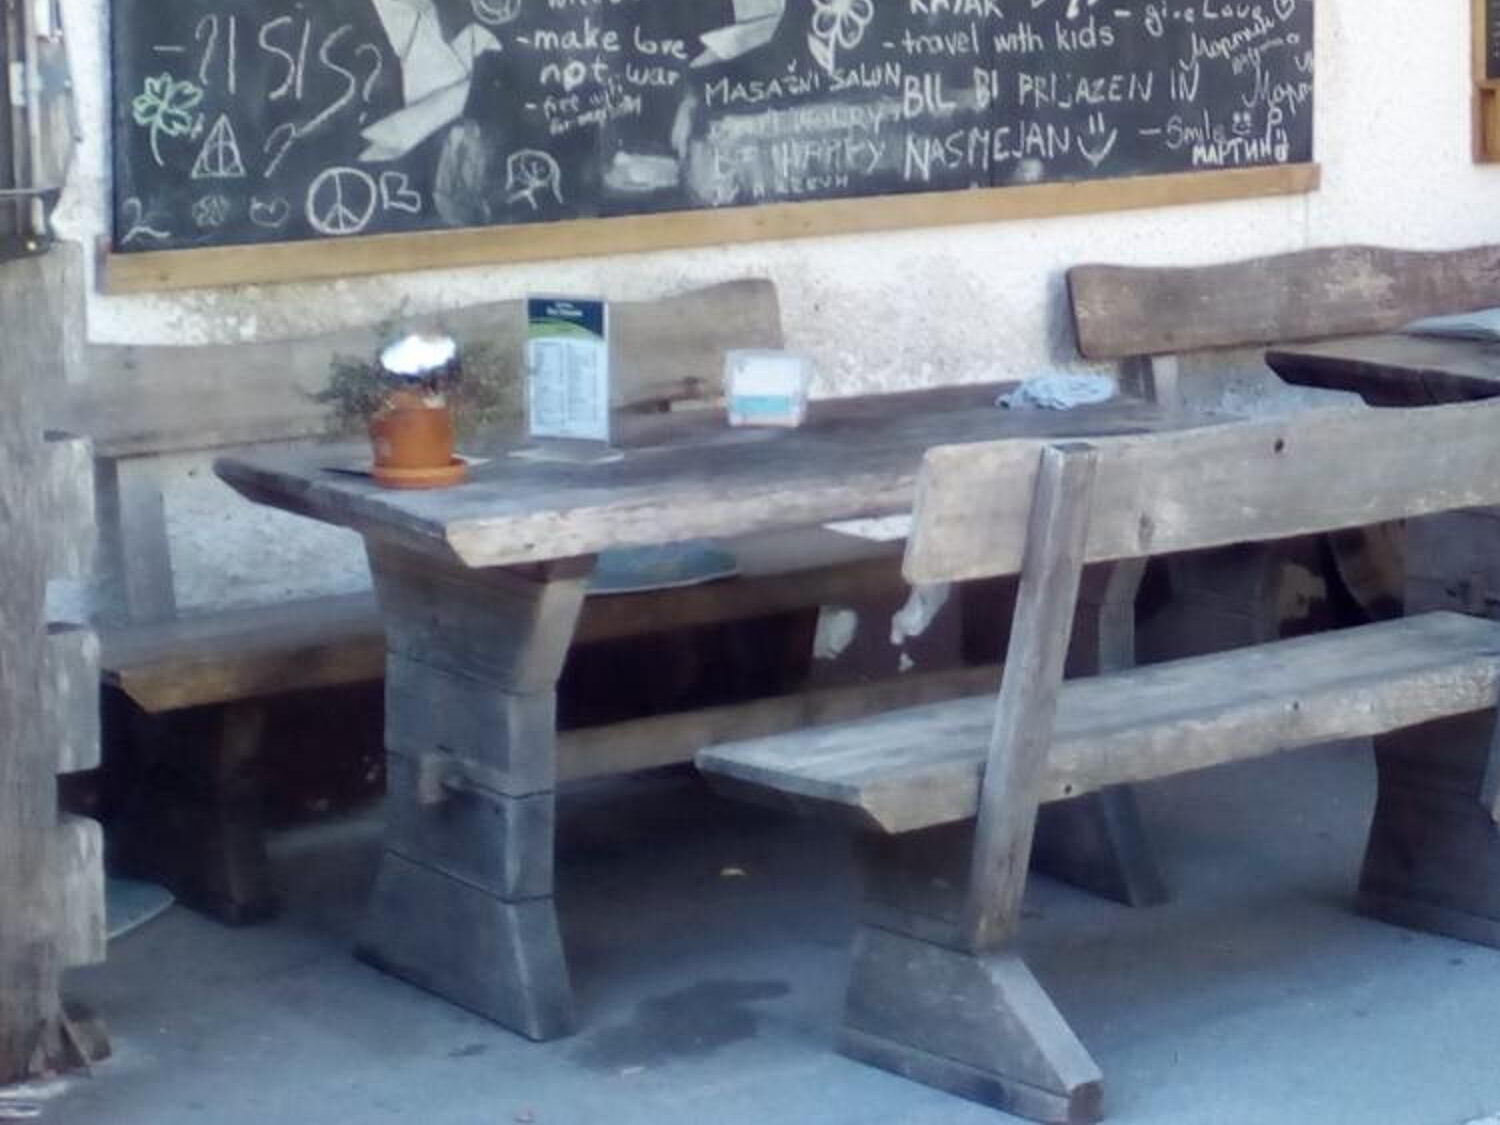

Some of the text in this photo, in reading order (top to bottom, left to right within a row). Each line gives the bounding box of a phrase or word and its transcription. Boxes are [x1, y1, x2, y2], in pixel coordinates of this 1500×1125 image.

[534, 17, 689, 60] make love
[901, 14, 1115, 55] travel with kids
[625, 62, 681, 87] war
[903, 72, 957, 119] BIL
[973, 66, 998, 111] BI
[1170, 64, 1200, 102] IN
[903, 120, 1071, 181] NASMEJAN
